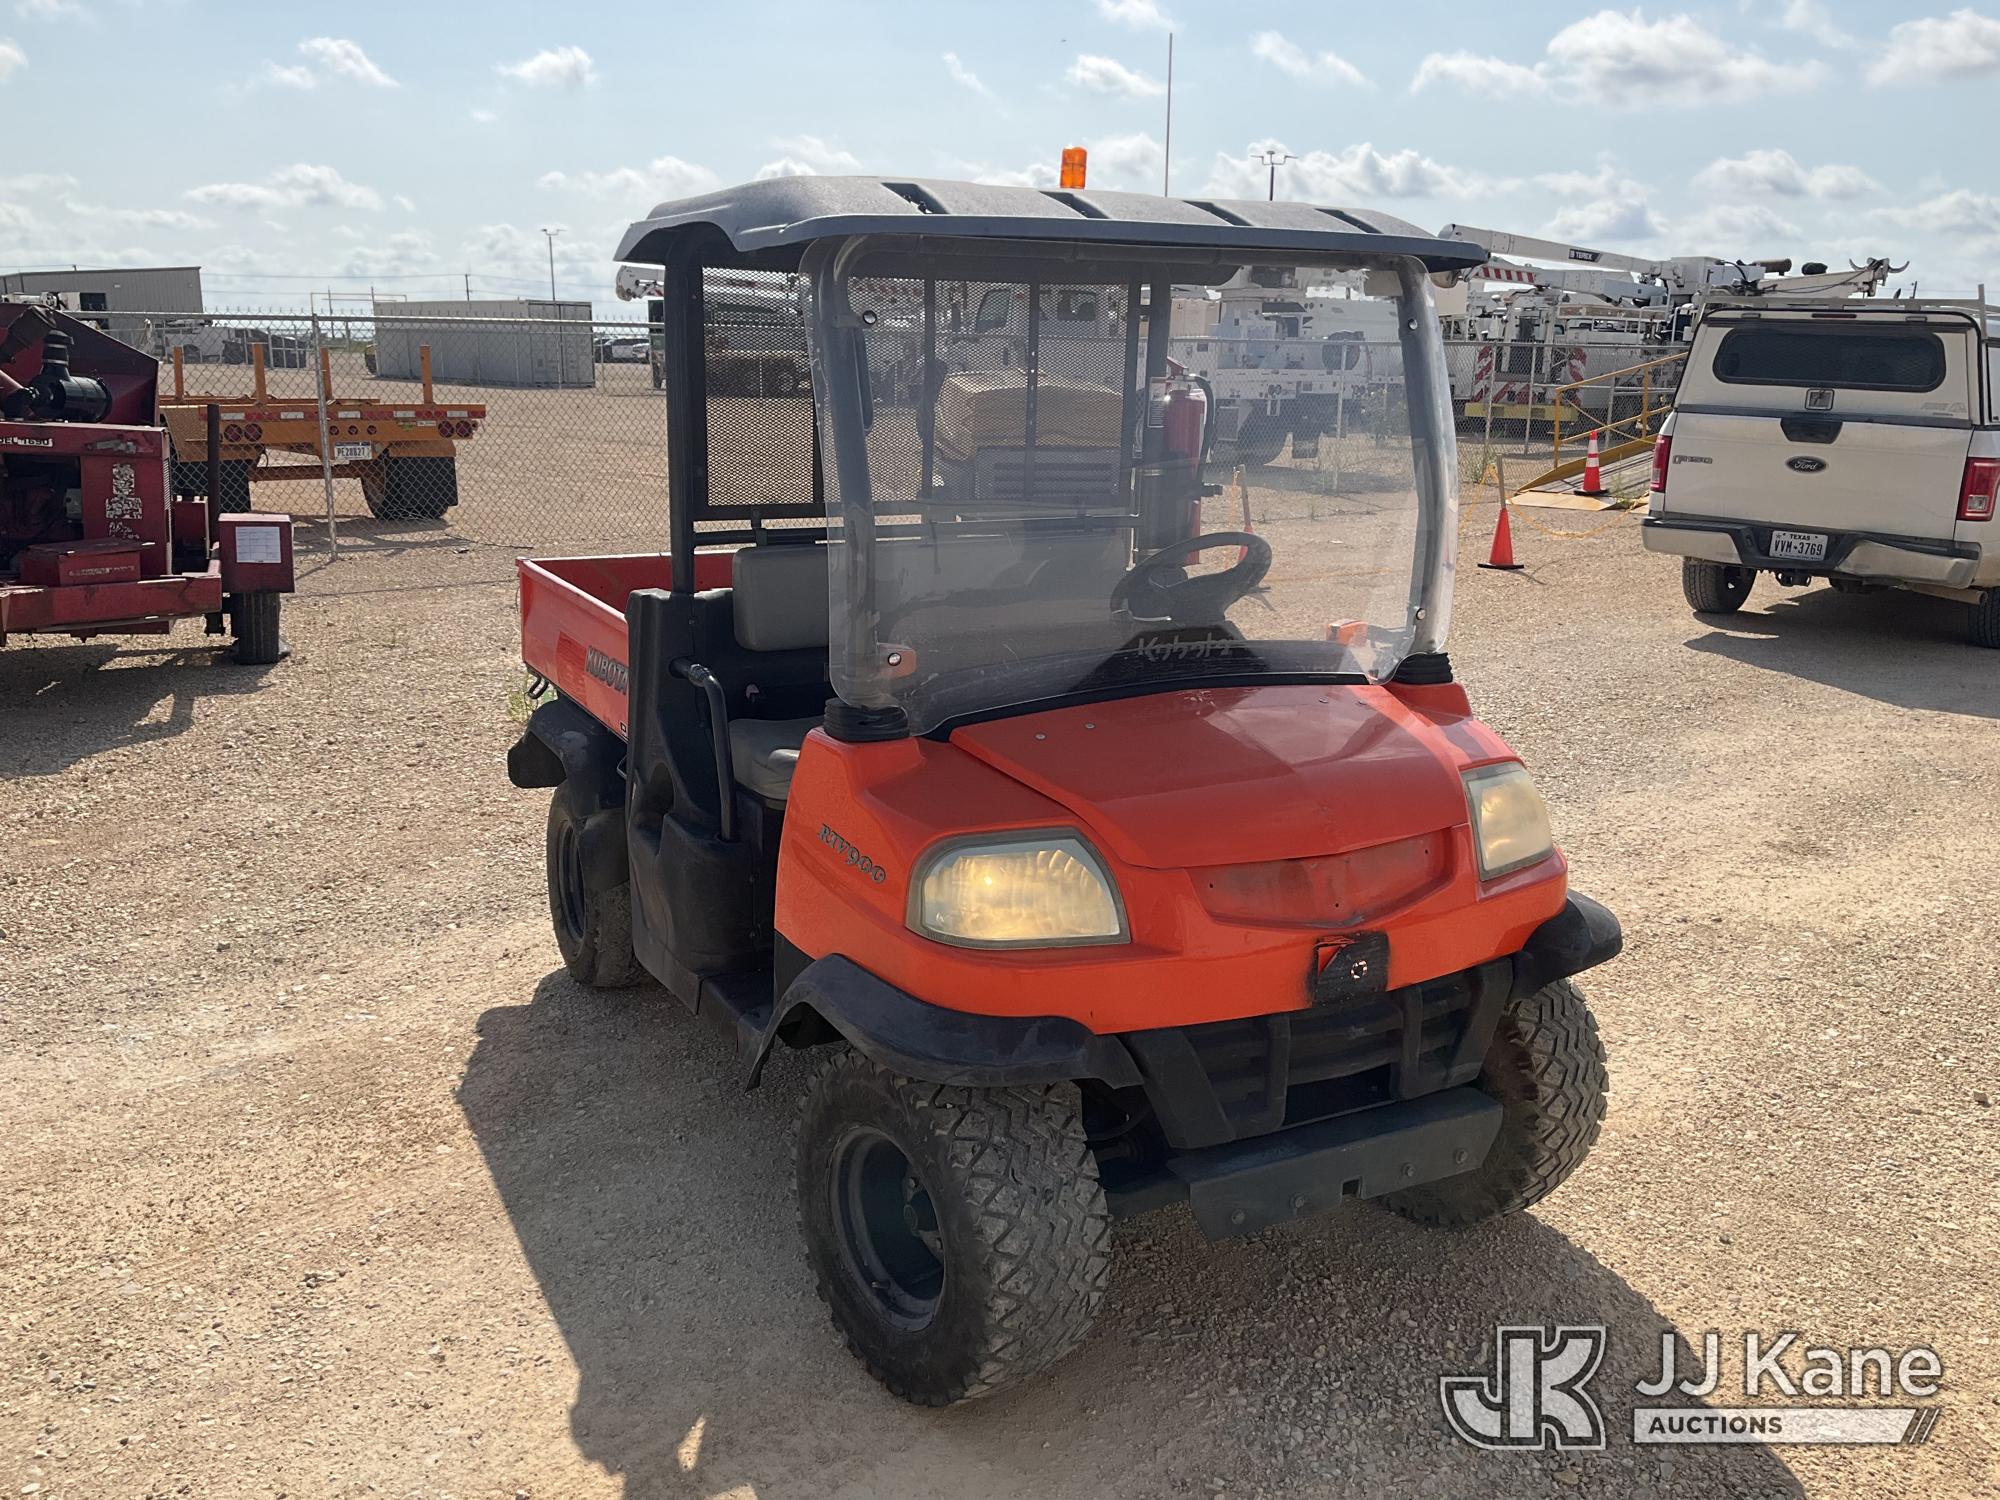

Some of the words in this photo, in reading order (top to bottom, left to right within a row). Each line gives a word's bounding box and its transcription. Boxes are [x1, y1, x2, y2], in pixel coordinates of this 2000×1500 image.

[1576, 251, 1593, 261] TEREX
[1790, 533, 1811, 541] TEXAS
[585, 645, 628, 695] KUBOTA
[816, 823, 886, 884] RTV900
